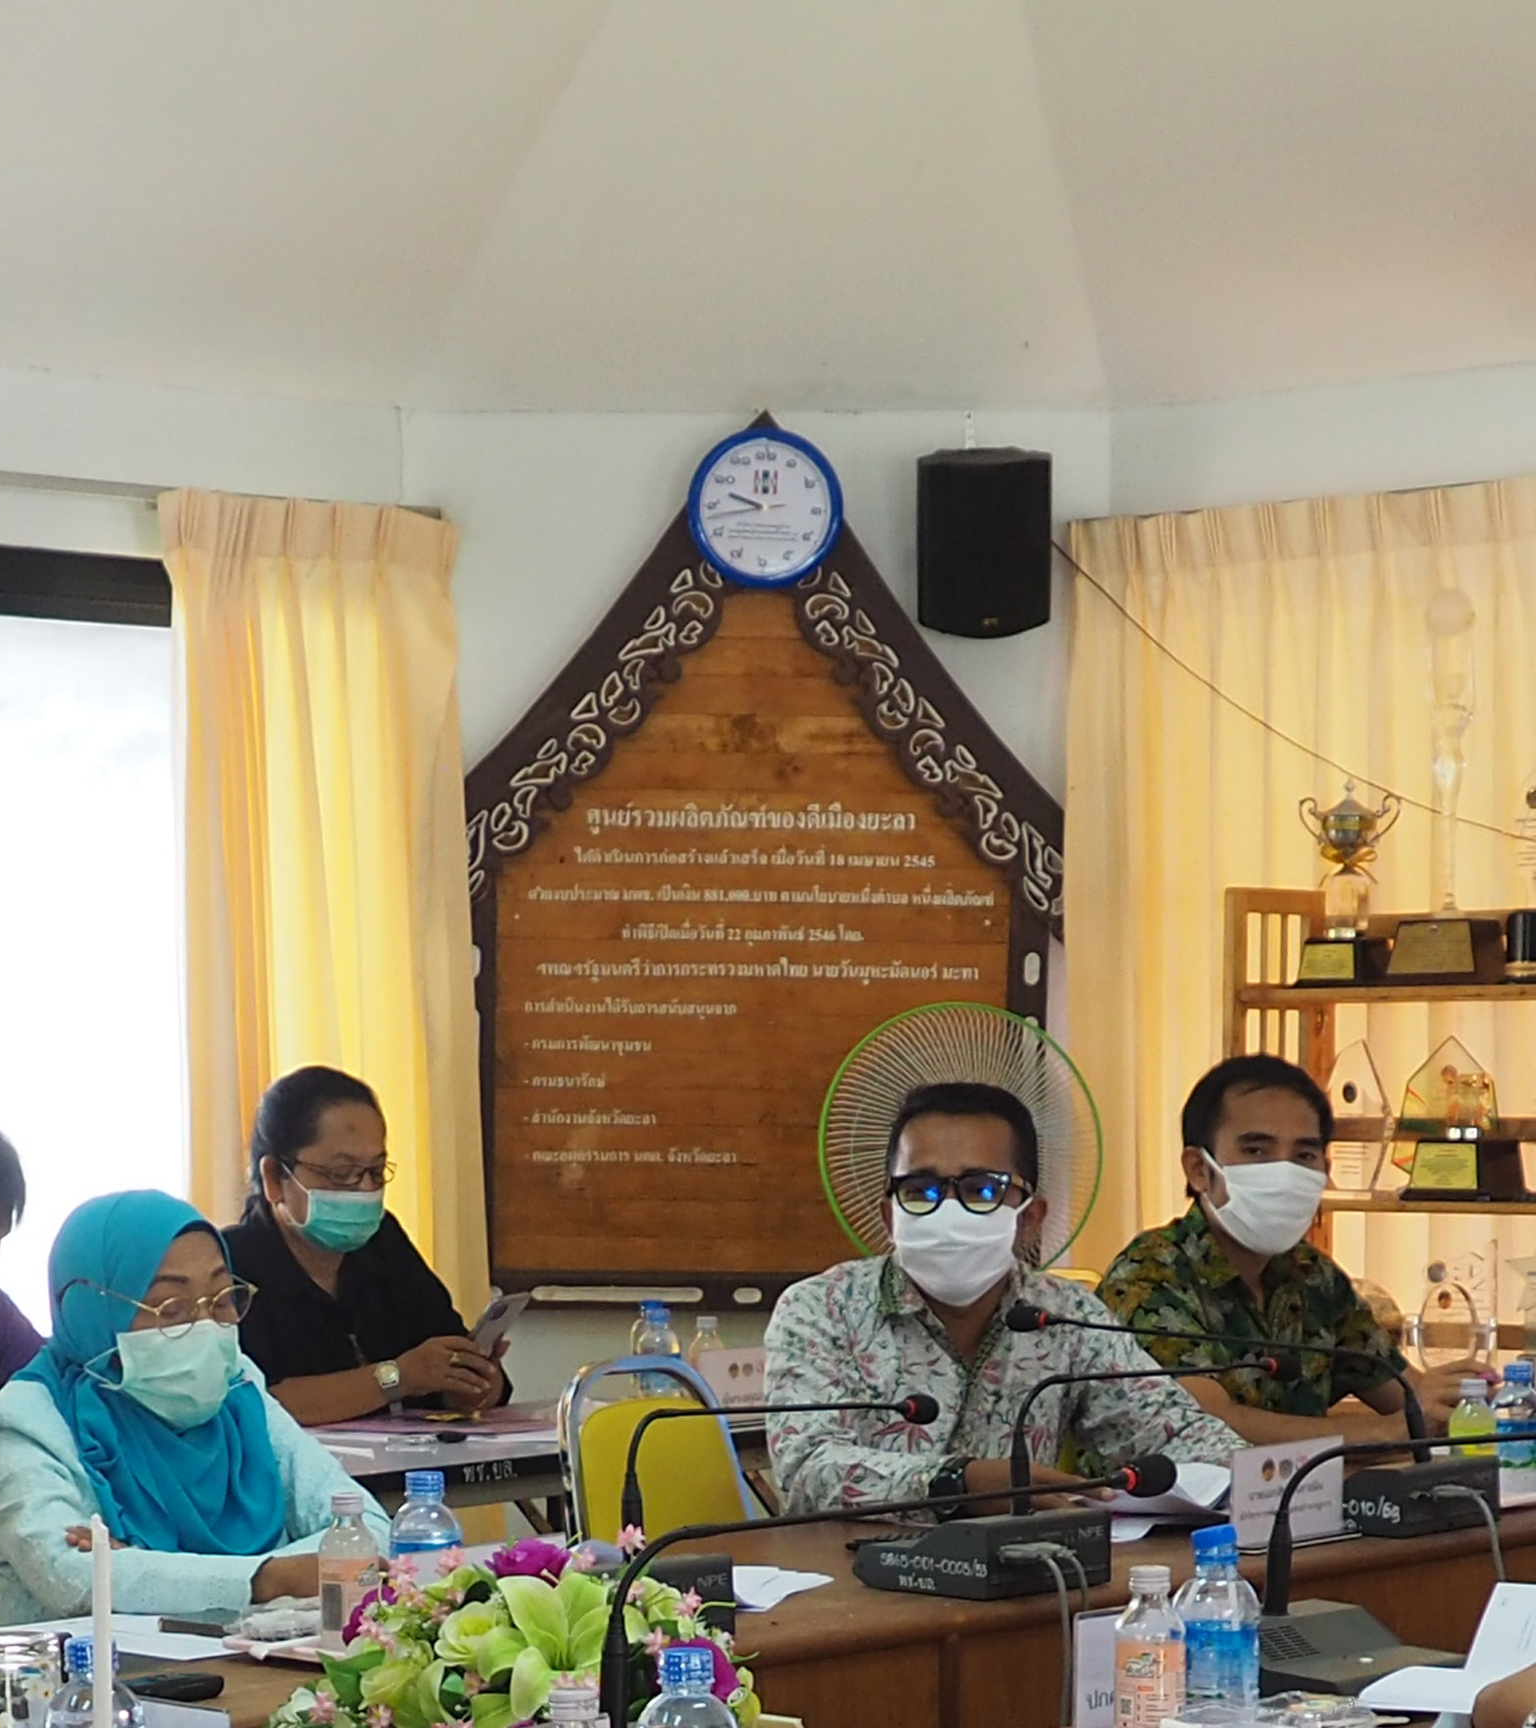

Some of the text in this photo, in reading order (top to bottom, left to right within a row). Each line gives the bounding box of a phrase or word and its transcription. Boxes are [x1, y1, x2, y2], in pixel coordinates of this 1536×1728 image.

[587, 802, 916, 834] ศูนย์รวมผลิตภัณฑ์ของดีเมืองยะลา
[770, 844, 825, 866] เมื่อวันที่
[830, 854, 845, 866] 18
[848, 854, 901, 867] เมษายน
[904, 855, 936, 868] 2545
[727, 928, 742, 941] 22
[745, 925, 805, 947] กุมภาพันธ์
[808, 928, 837, 941] 2546
[942, 966, 979, 980] มะทา
